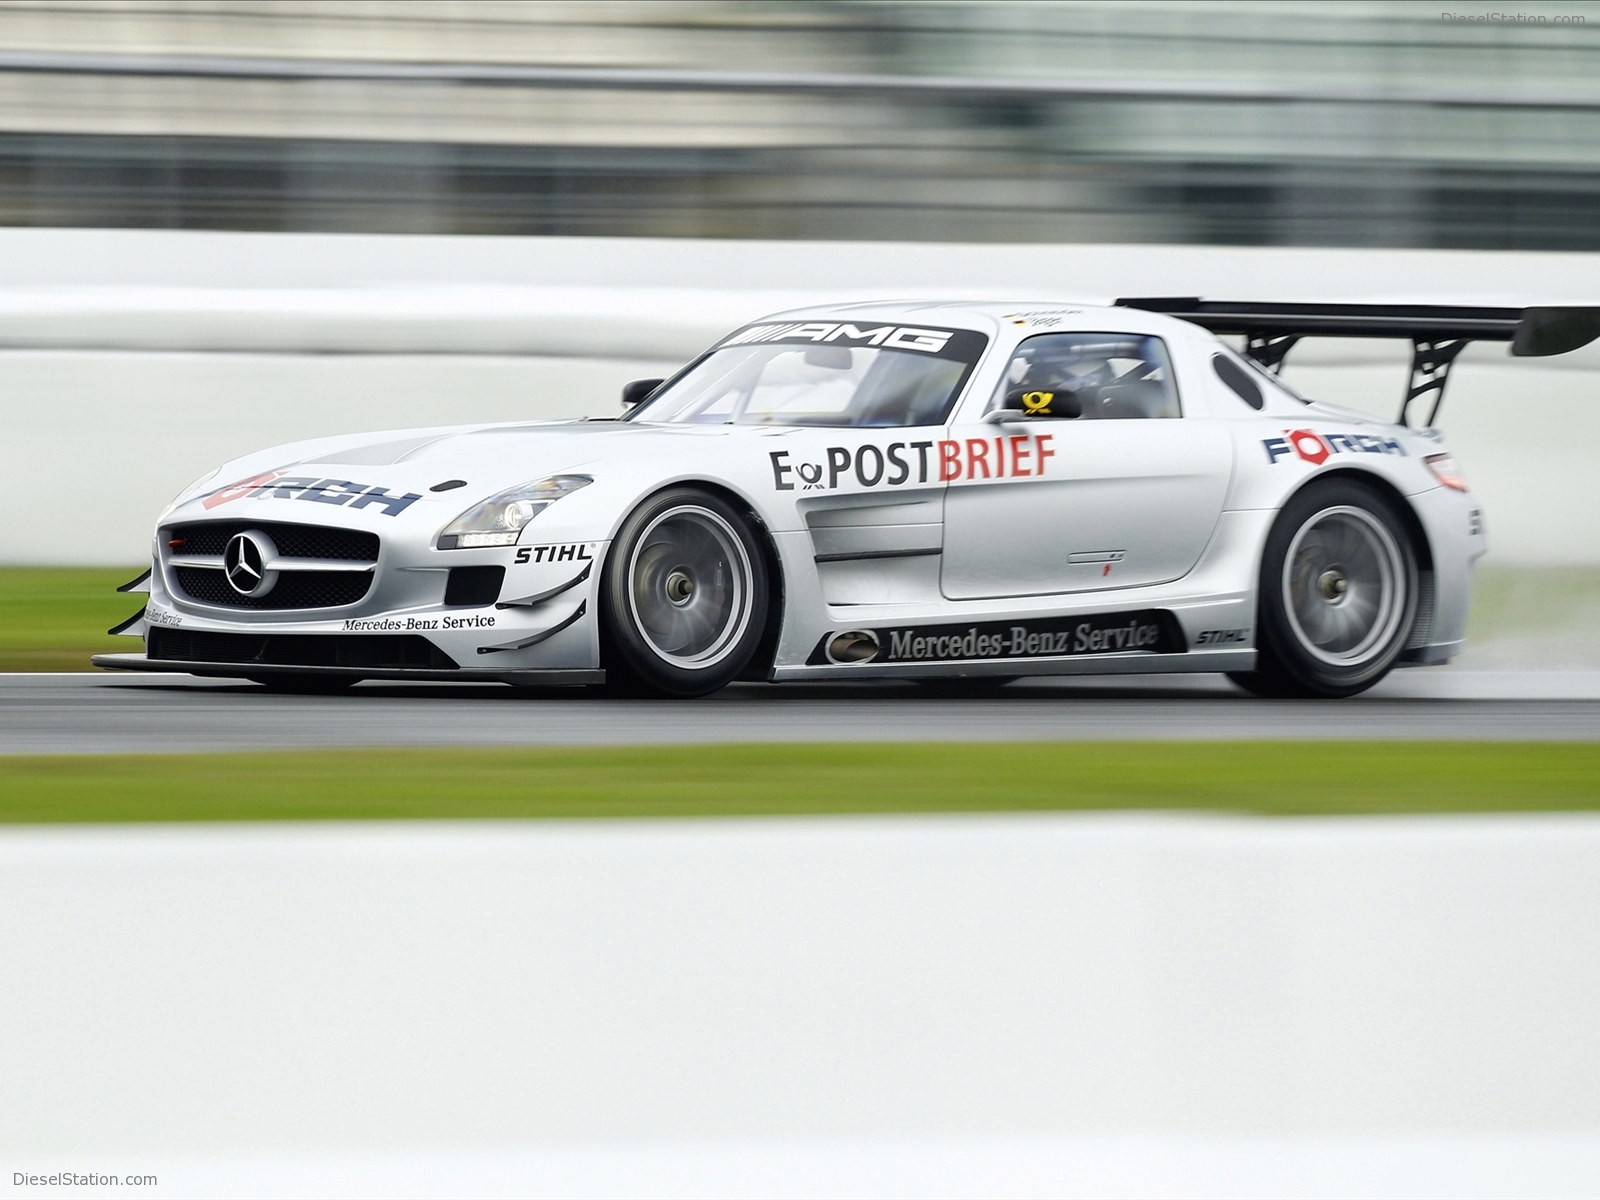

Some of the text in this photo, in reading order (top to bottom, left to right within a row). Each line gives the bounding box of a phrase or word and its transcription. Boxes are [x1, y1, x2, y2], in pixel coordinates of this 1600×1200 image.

[769, 323, 954, 353] AMG
[514, 544, 593, 564] STIHL
[342, 615, 495, 631] Mercedes-Benz Service
[888, 620, 1160, 659] Mercedes-Benz Service
